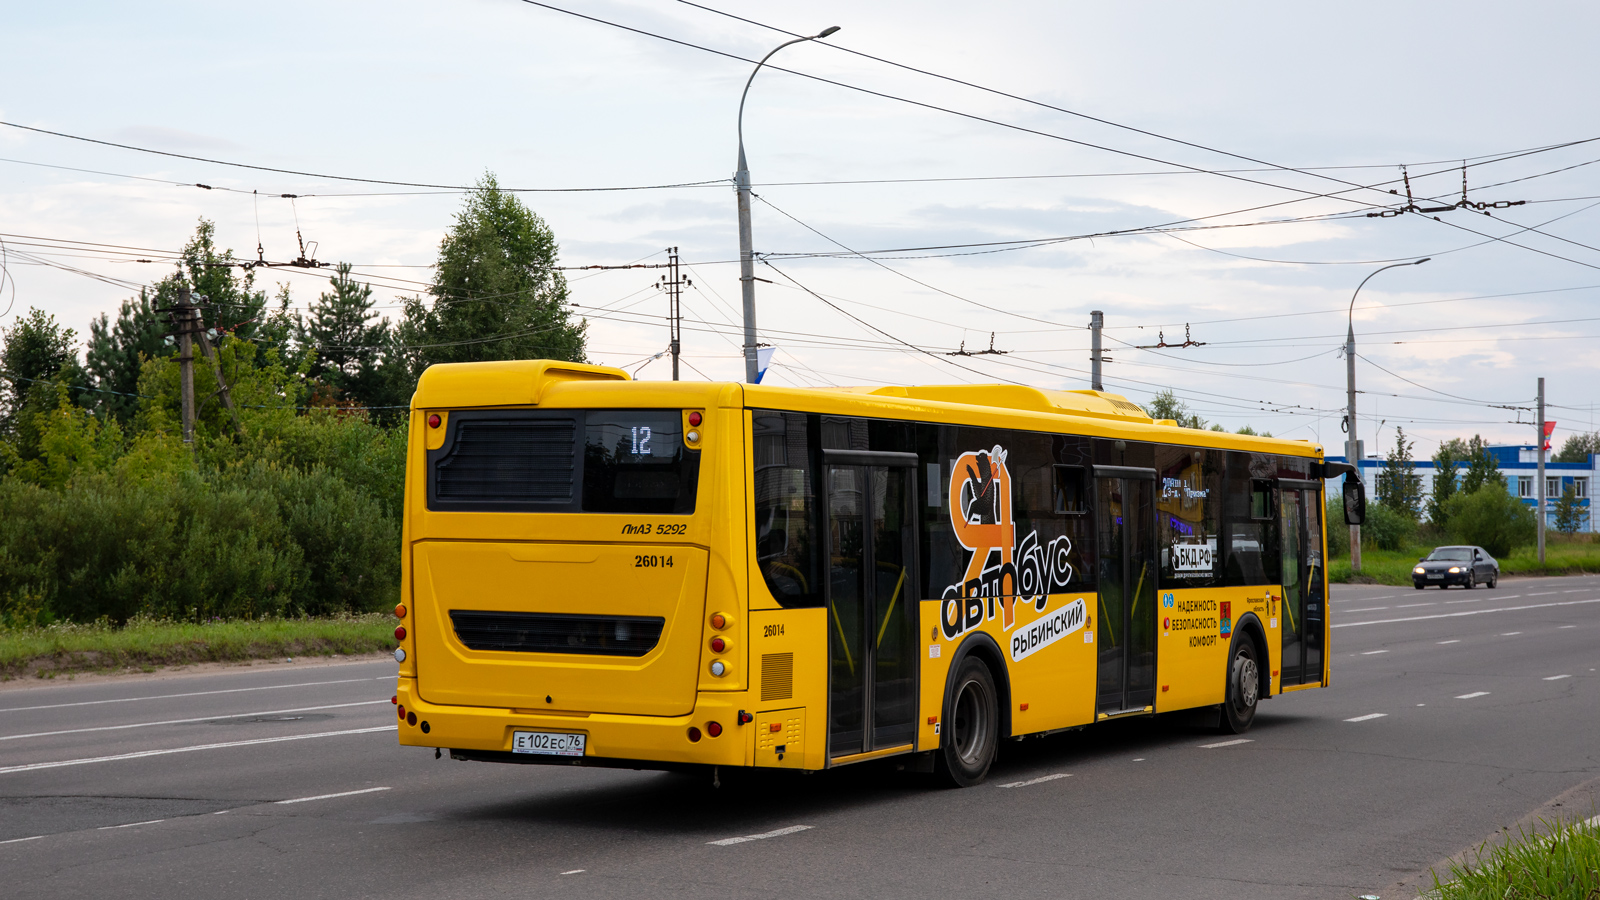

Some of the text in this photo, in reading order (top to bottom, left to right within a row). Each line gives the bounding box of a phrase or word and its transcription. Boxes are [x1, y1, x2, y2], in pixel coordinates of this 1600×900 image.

[631, 426, 651, 454] 12
[656, 523, 687, 535] 5292
[635, 555, 673, 568] 26014
[1180, 548, 1211, 568] БКД.РФ
[940, 530, 1072, 641] автобус
[1178, 600, 1217, 613] НАДЕЖНОСТЬ
[763, 624, 785, 638] 26014
[1012, 599, 1084, 658] РЫБИНСКИЙ
[1172, 619, 1217, 631] БЕЗОПАСНОСТЬ
[1189, 635, 1217, 647] КОМФОРТ
[568, 735, 581, 747] 76
